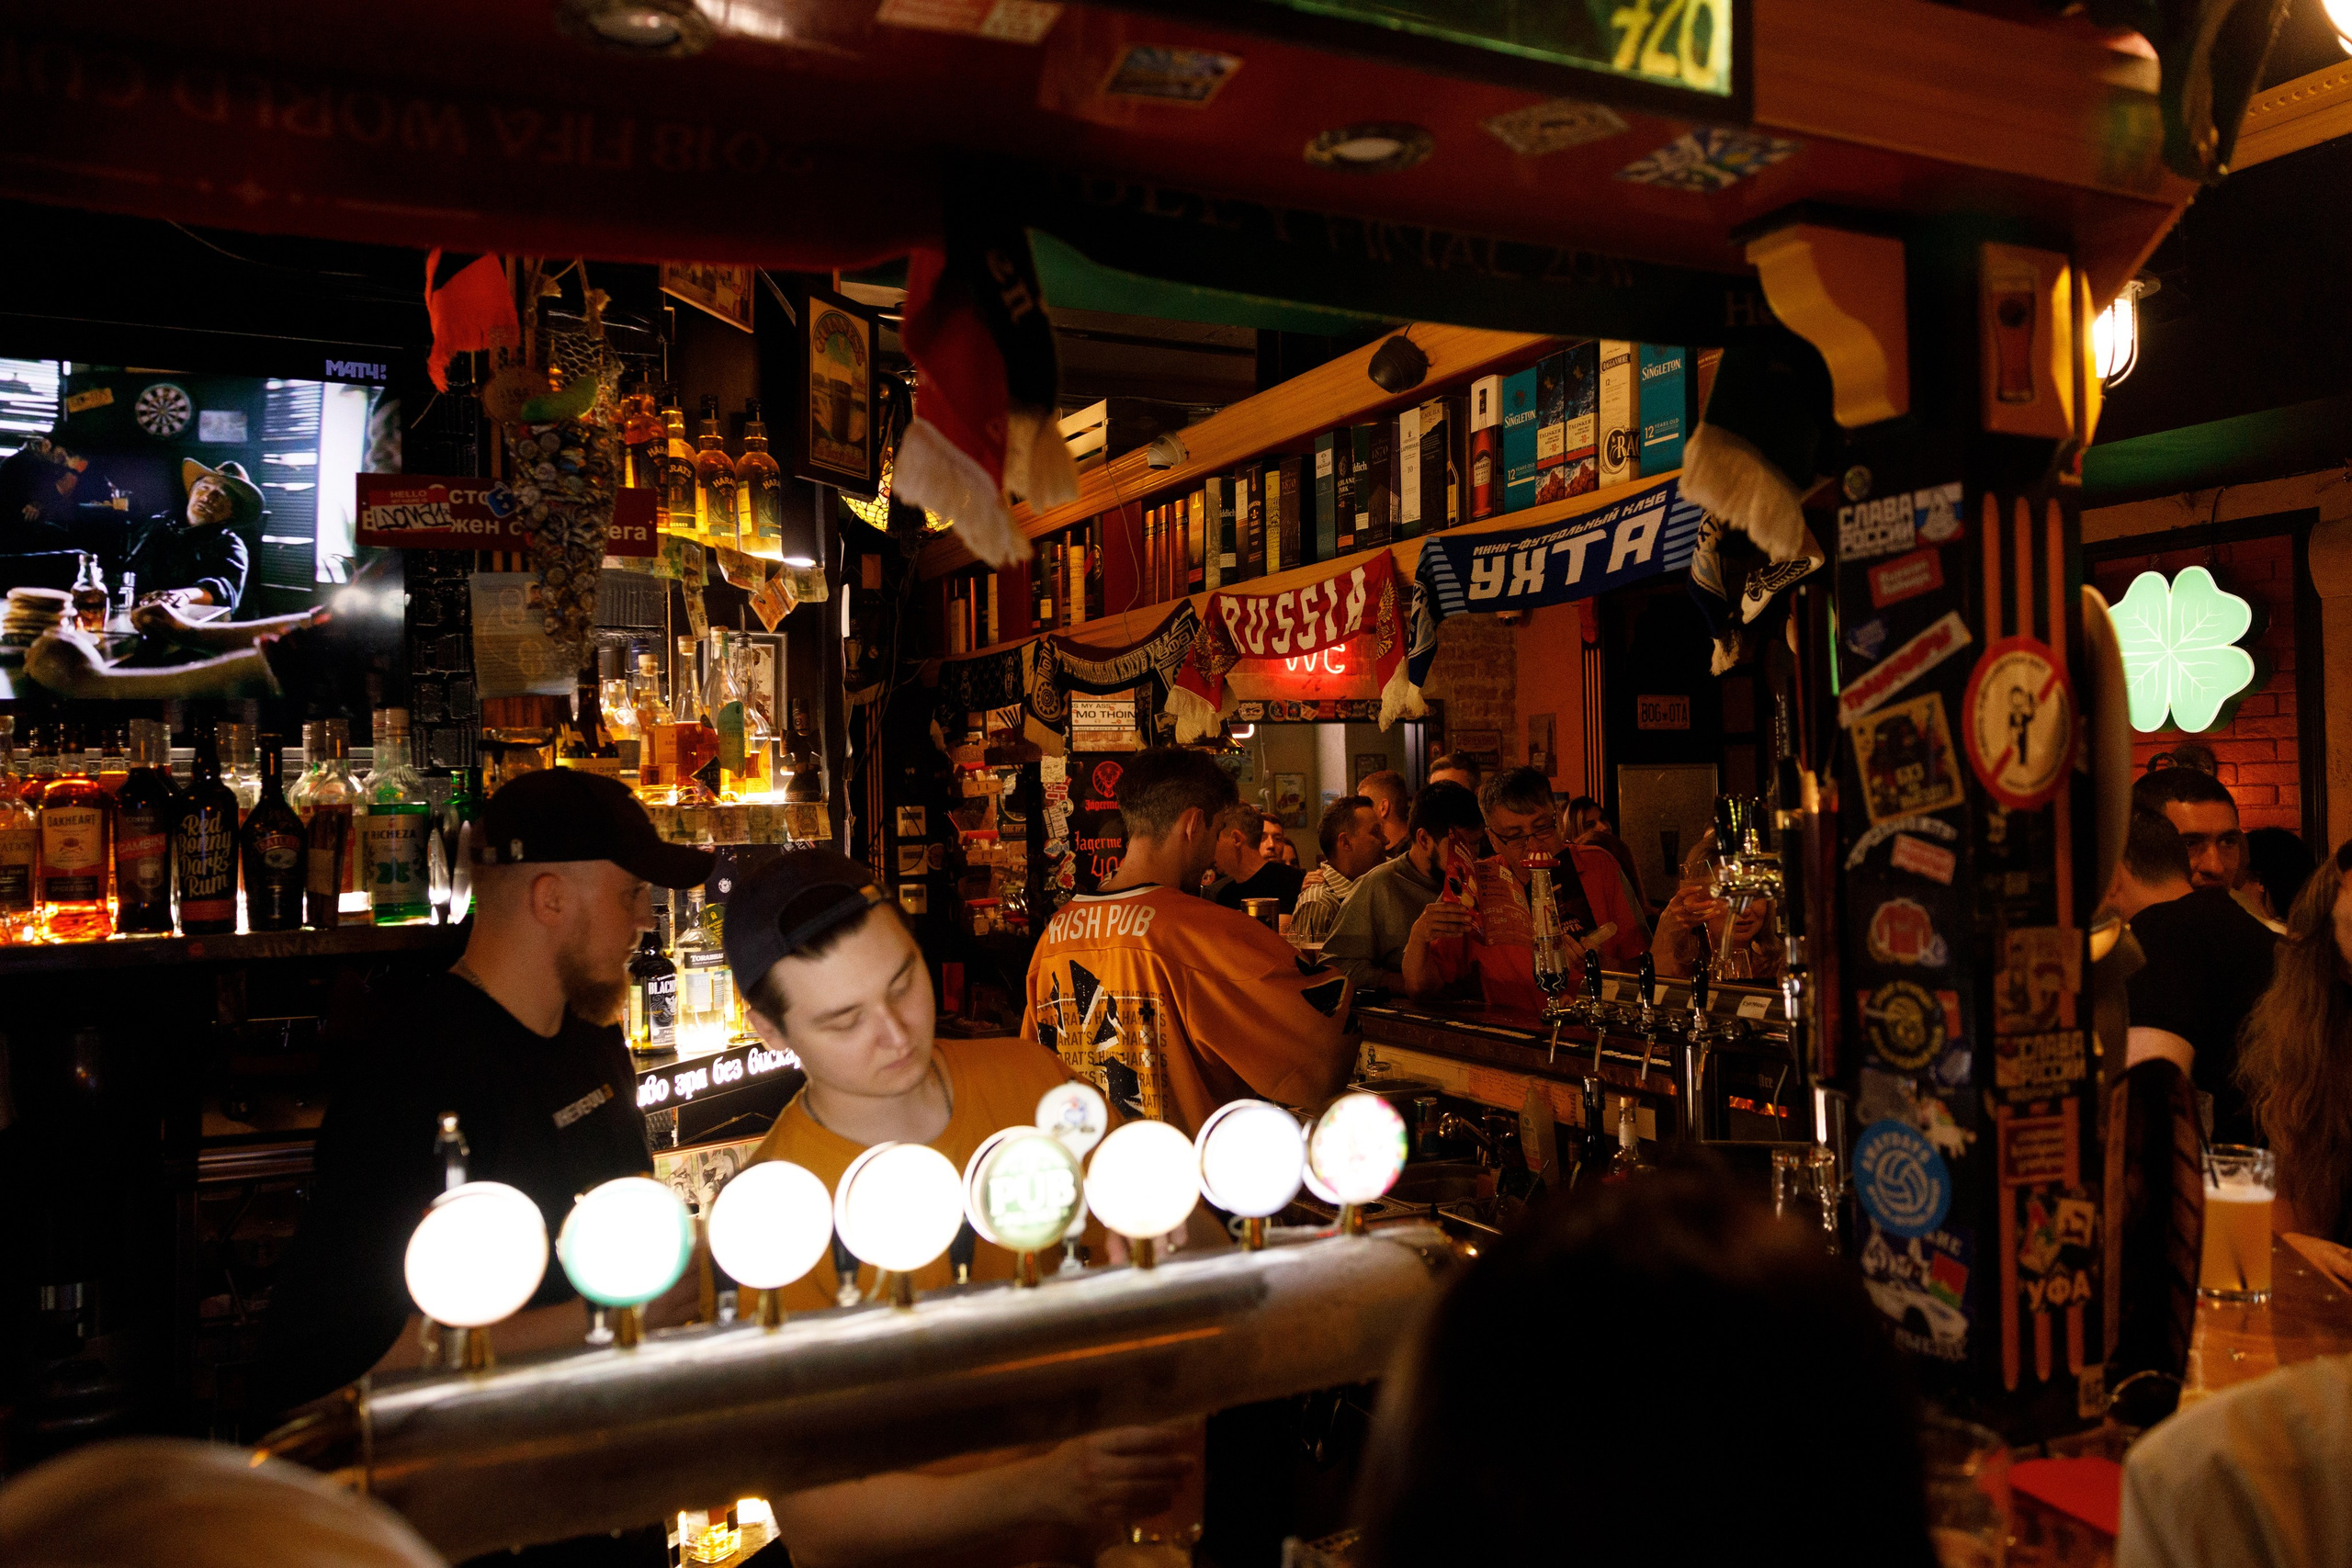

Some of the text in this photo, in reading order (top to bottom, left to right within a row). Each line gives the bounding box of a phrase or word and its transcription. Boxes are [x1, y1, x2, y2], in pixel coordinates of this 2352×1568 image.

[171, 70, 469, 159] WORLD
[487, 105, 635, 173] FIFA
[650, 123, 817, 178] 2018
[1642, 358, 1681, 381] SINGLETON
[1504, 409, 1536, 429] SINGLETON
[1568, 419, 1591, 431] TALISKER
[1538, 428, 1562, 439] TALISKER
[1645, 425, 1655, 439] 12
[1372, 446, 1388, 459] 1870
[1507, 469, 1516, 481] 12
[390, 490, 427, 499] HELLO
[1621, 490, 1669, 519] КЛУБ
[608, 524, 648, 541] ега
[1468, 504, 1668, 600] УХТА
[1219, 566, 1367, 655] RUSSIA
[1640, 702, 1689, 724] BOG OTA
[48, 814, 96, 828] OAKHEART
[180, 810, 222, 837] Red
[177, 830, 232, 859] Bonny
[370, 829, 417, 840] RICHEZA
[1074, 829, 1122, 857] Jagerme
[179, 851, 232, 877] Dark
[184, 874, 230, 897] Rum
[1048, 904, 1157, 944] RISH PUB
[690, 953, 724, 963] TORABHAI
[1057, 1031, 1092, 1046] ARAT'S
[1059, 1051, 1095, 1066] ARAT'S
[673, 1067, 708, 1100] зря
[712, 1056, 743, 1086] без
[1139, 1072, 1169, 1089] RAT'S
[989, 1168, 1077, 1217] PUB
[2026, 1269, 2093, 1312] УФА
